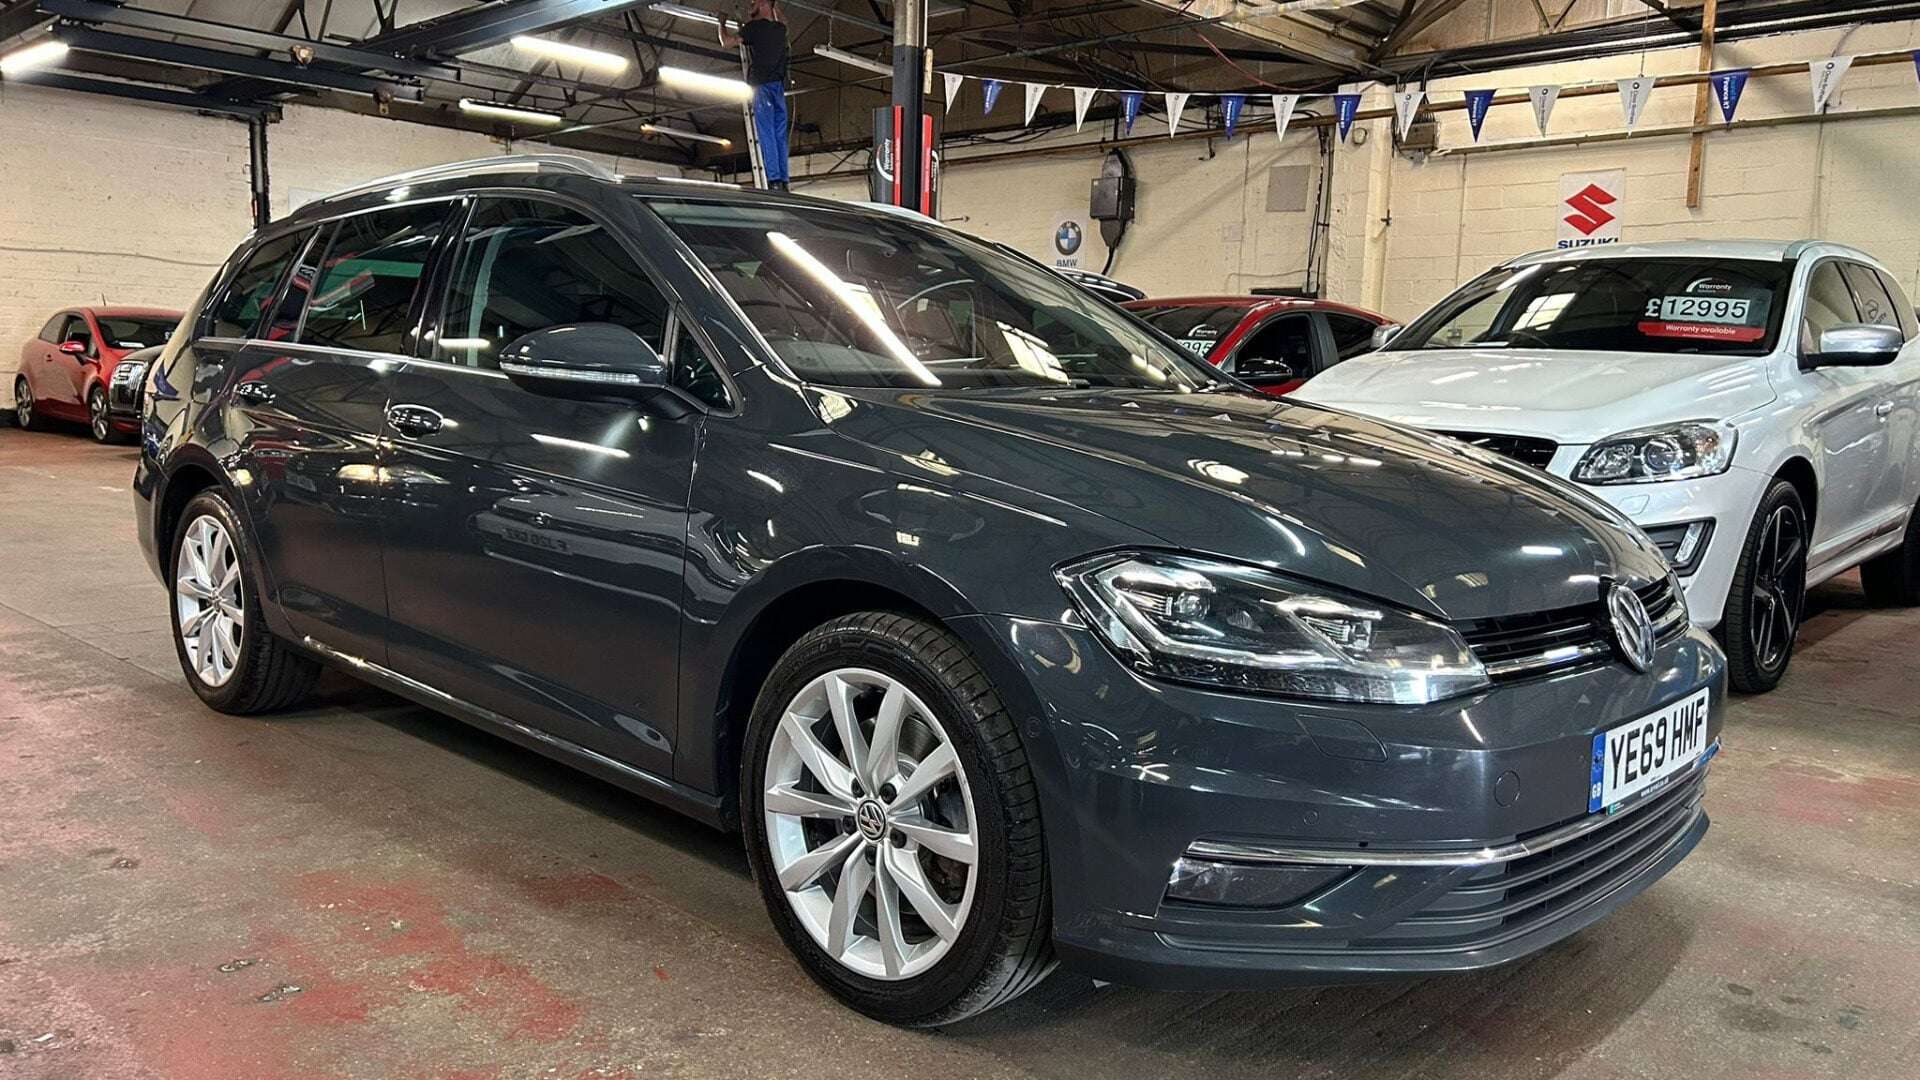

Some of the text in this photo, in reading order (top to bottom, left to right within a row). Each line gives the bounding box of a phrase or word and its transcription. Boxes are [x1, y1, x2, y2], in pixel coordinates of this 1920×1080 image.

[1056, 259, 1077, 268] BMW
[1699, 283, 1731, 291] Warranty
[1645, 297, 1746, 318] £12995
[1665, 324, 1736, 334] Warranty available
[1610, 696, 1706, 790] YE69 HMF
[1591, 782, 1602, 799] GB
